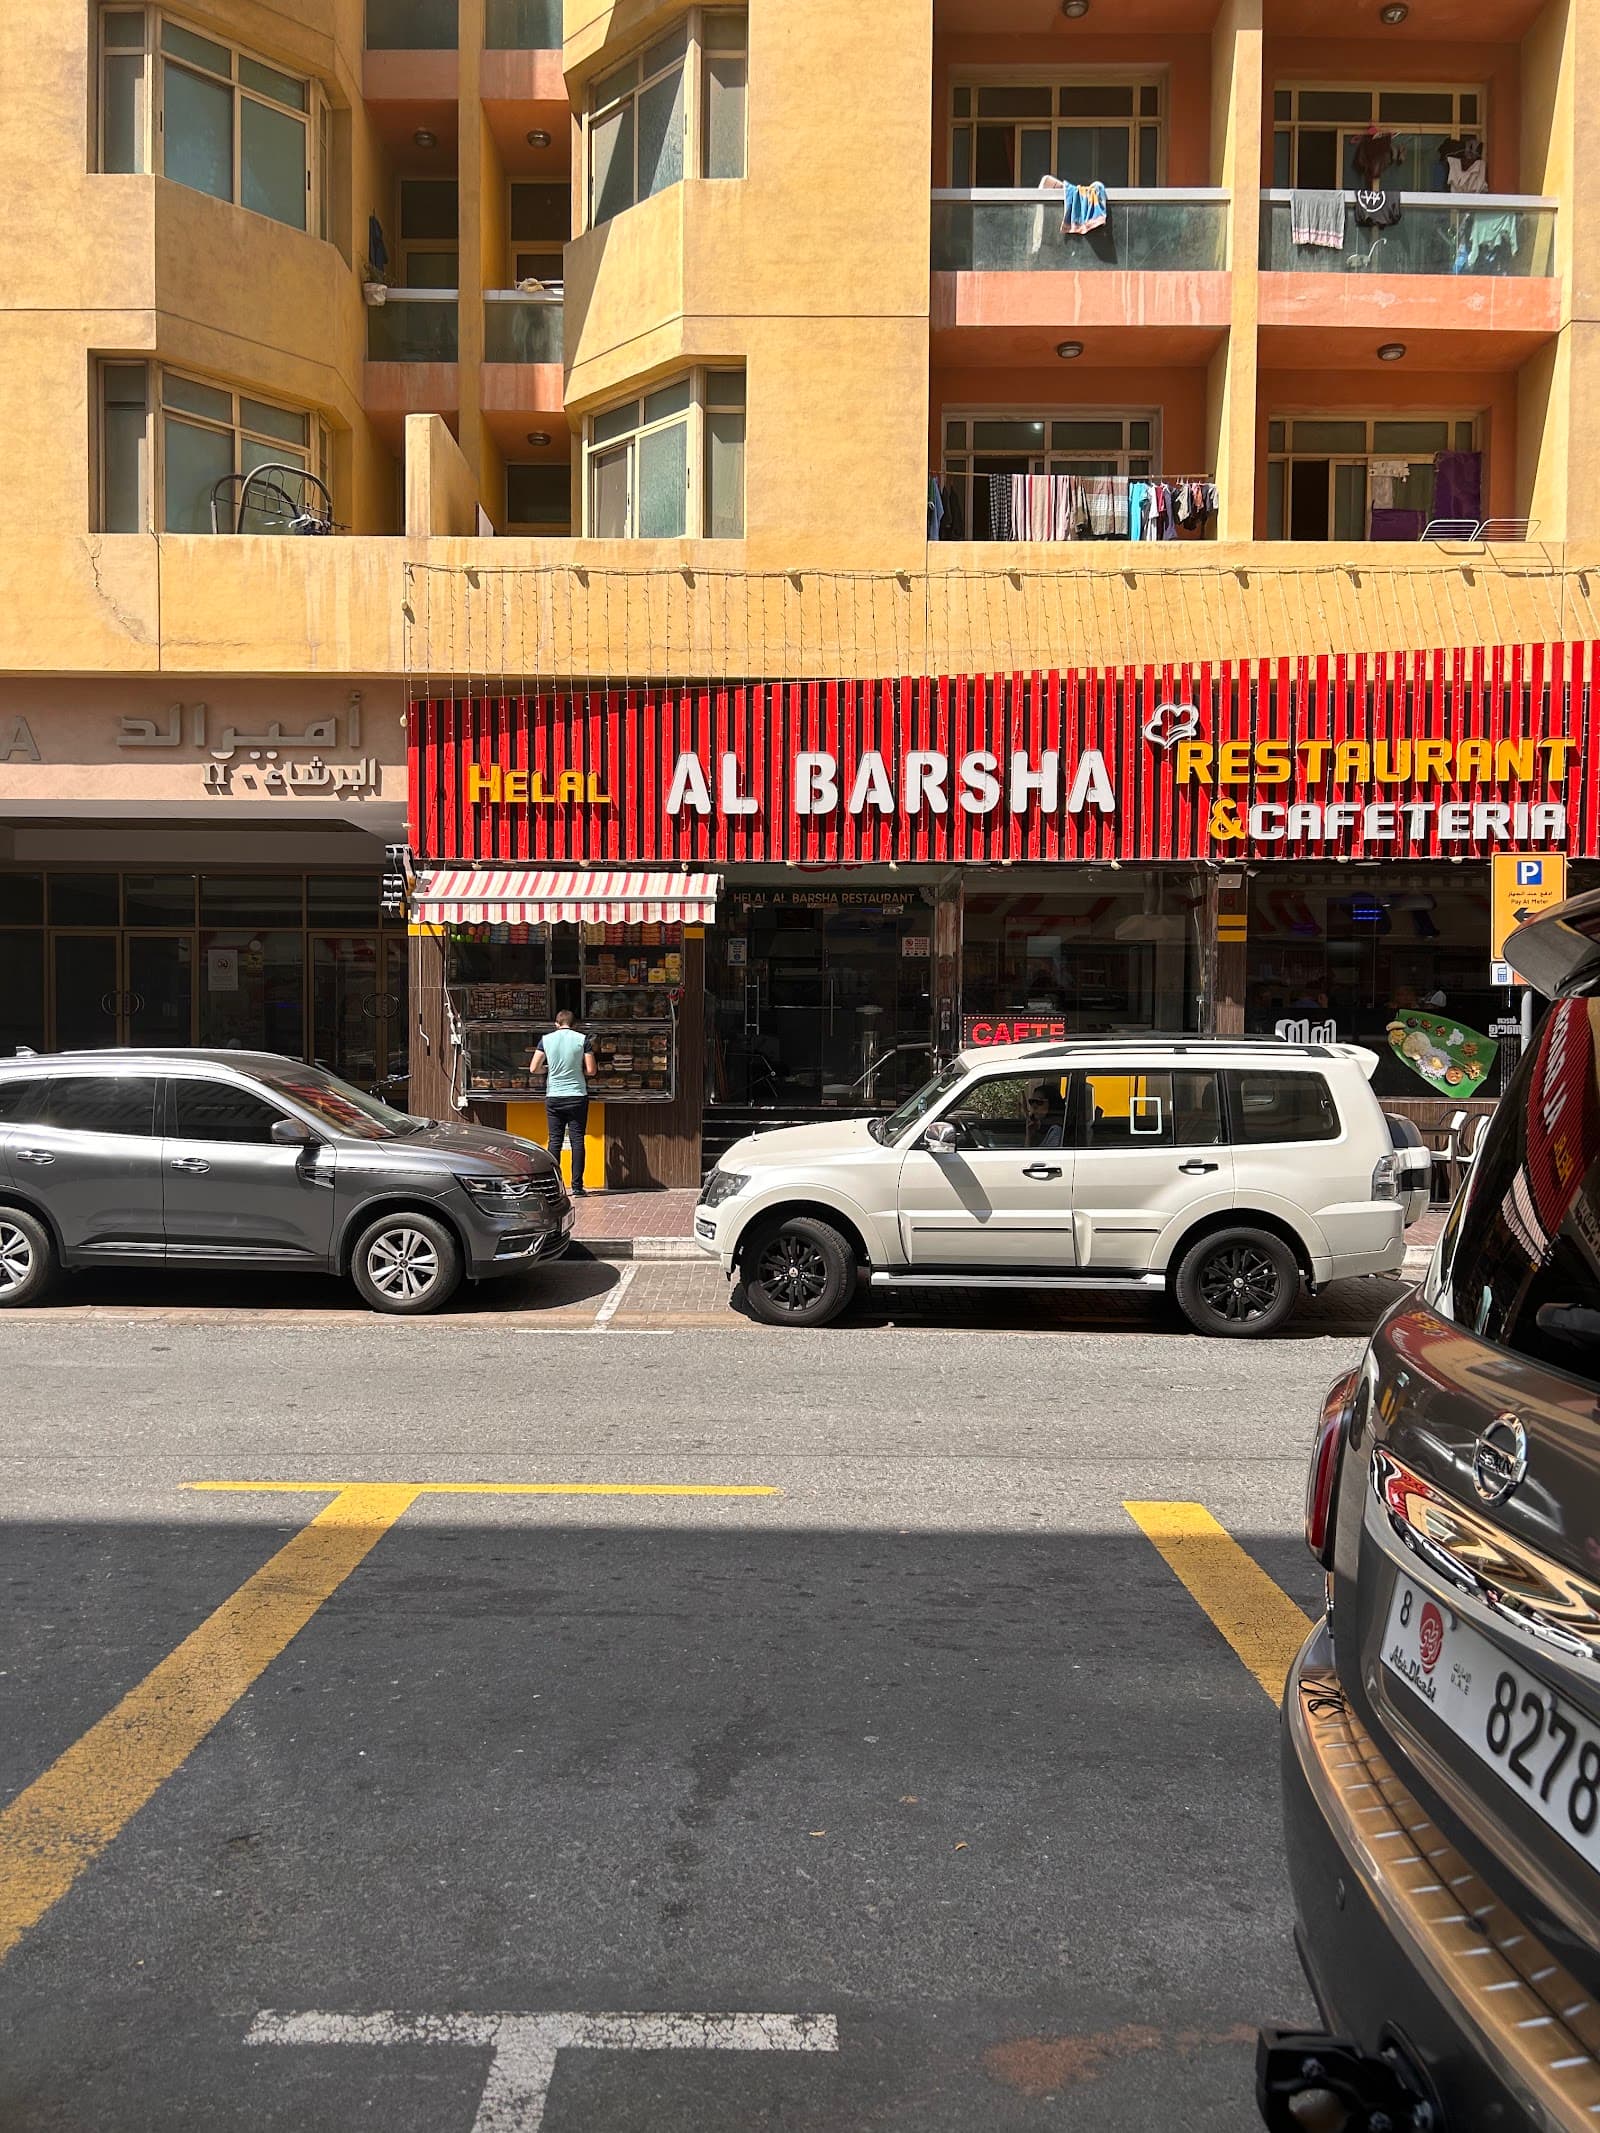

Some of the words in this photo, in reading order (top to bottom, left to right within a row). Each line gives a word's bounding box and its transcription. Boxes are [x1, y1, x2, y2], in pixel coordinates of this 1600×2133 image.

[1176, 737, 1576, 784] RESTAURANT
[468, 763, 611, 803] HELAL
[666, 751, 758, 815] AL
[795, 751, 1116, 815] BARSHA
[1520, 861, 1539, 885] P
[733, 893, 767, 904] HELAL
[772, 893, 787, 904] AL
[792, 893, 839, 904] BARSHA
[842, 893, 915, 904] RESTAURANT
[1400, 1590, 1413, 1626] 8
[1486, 1671, 1600, 1834] 8278
